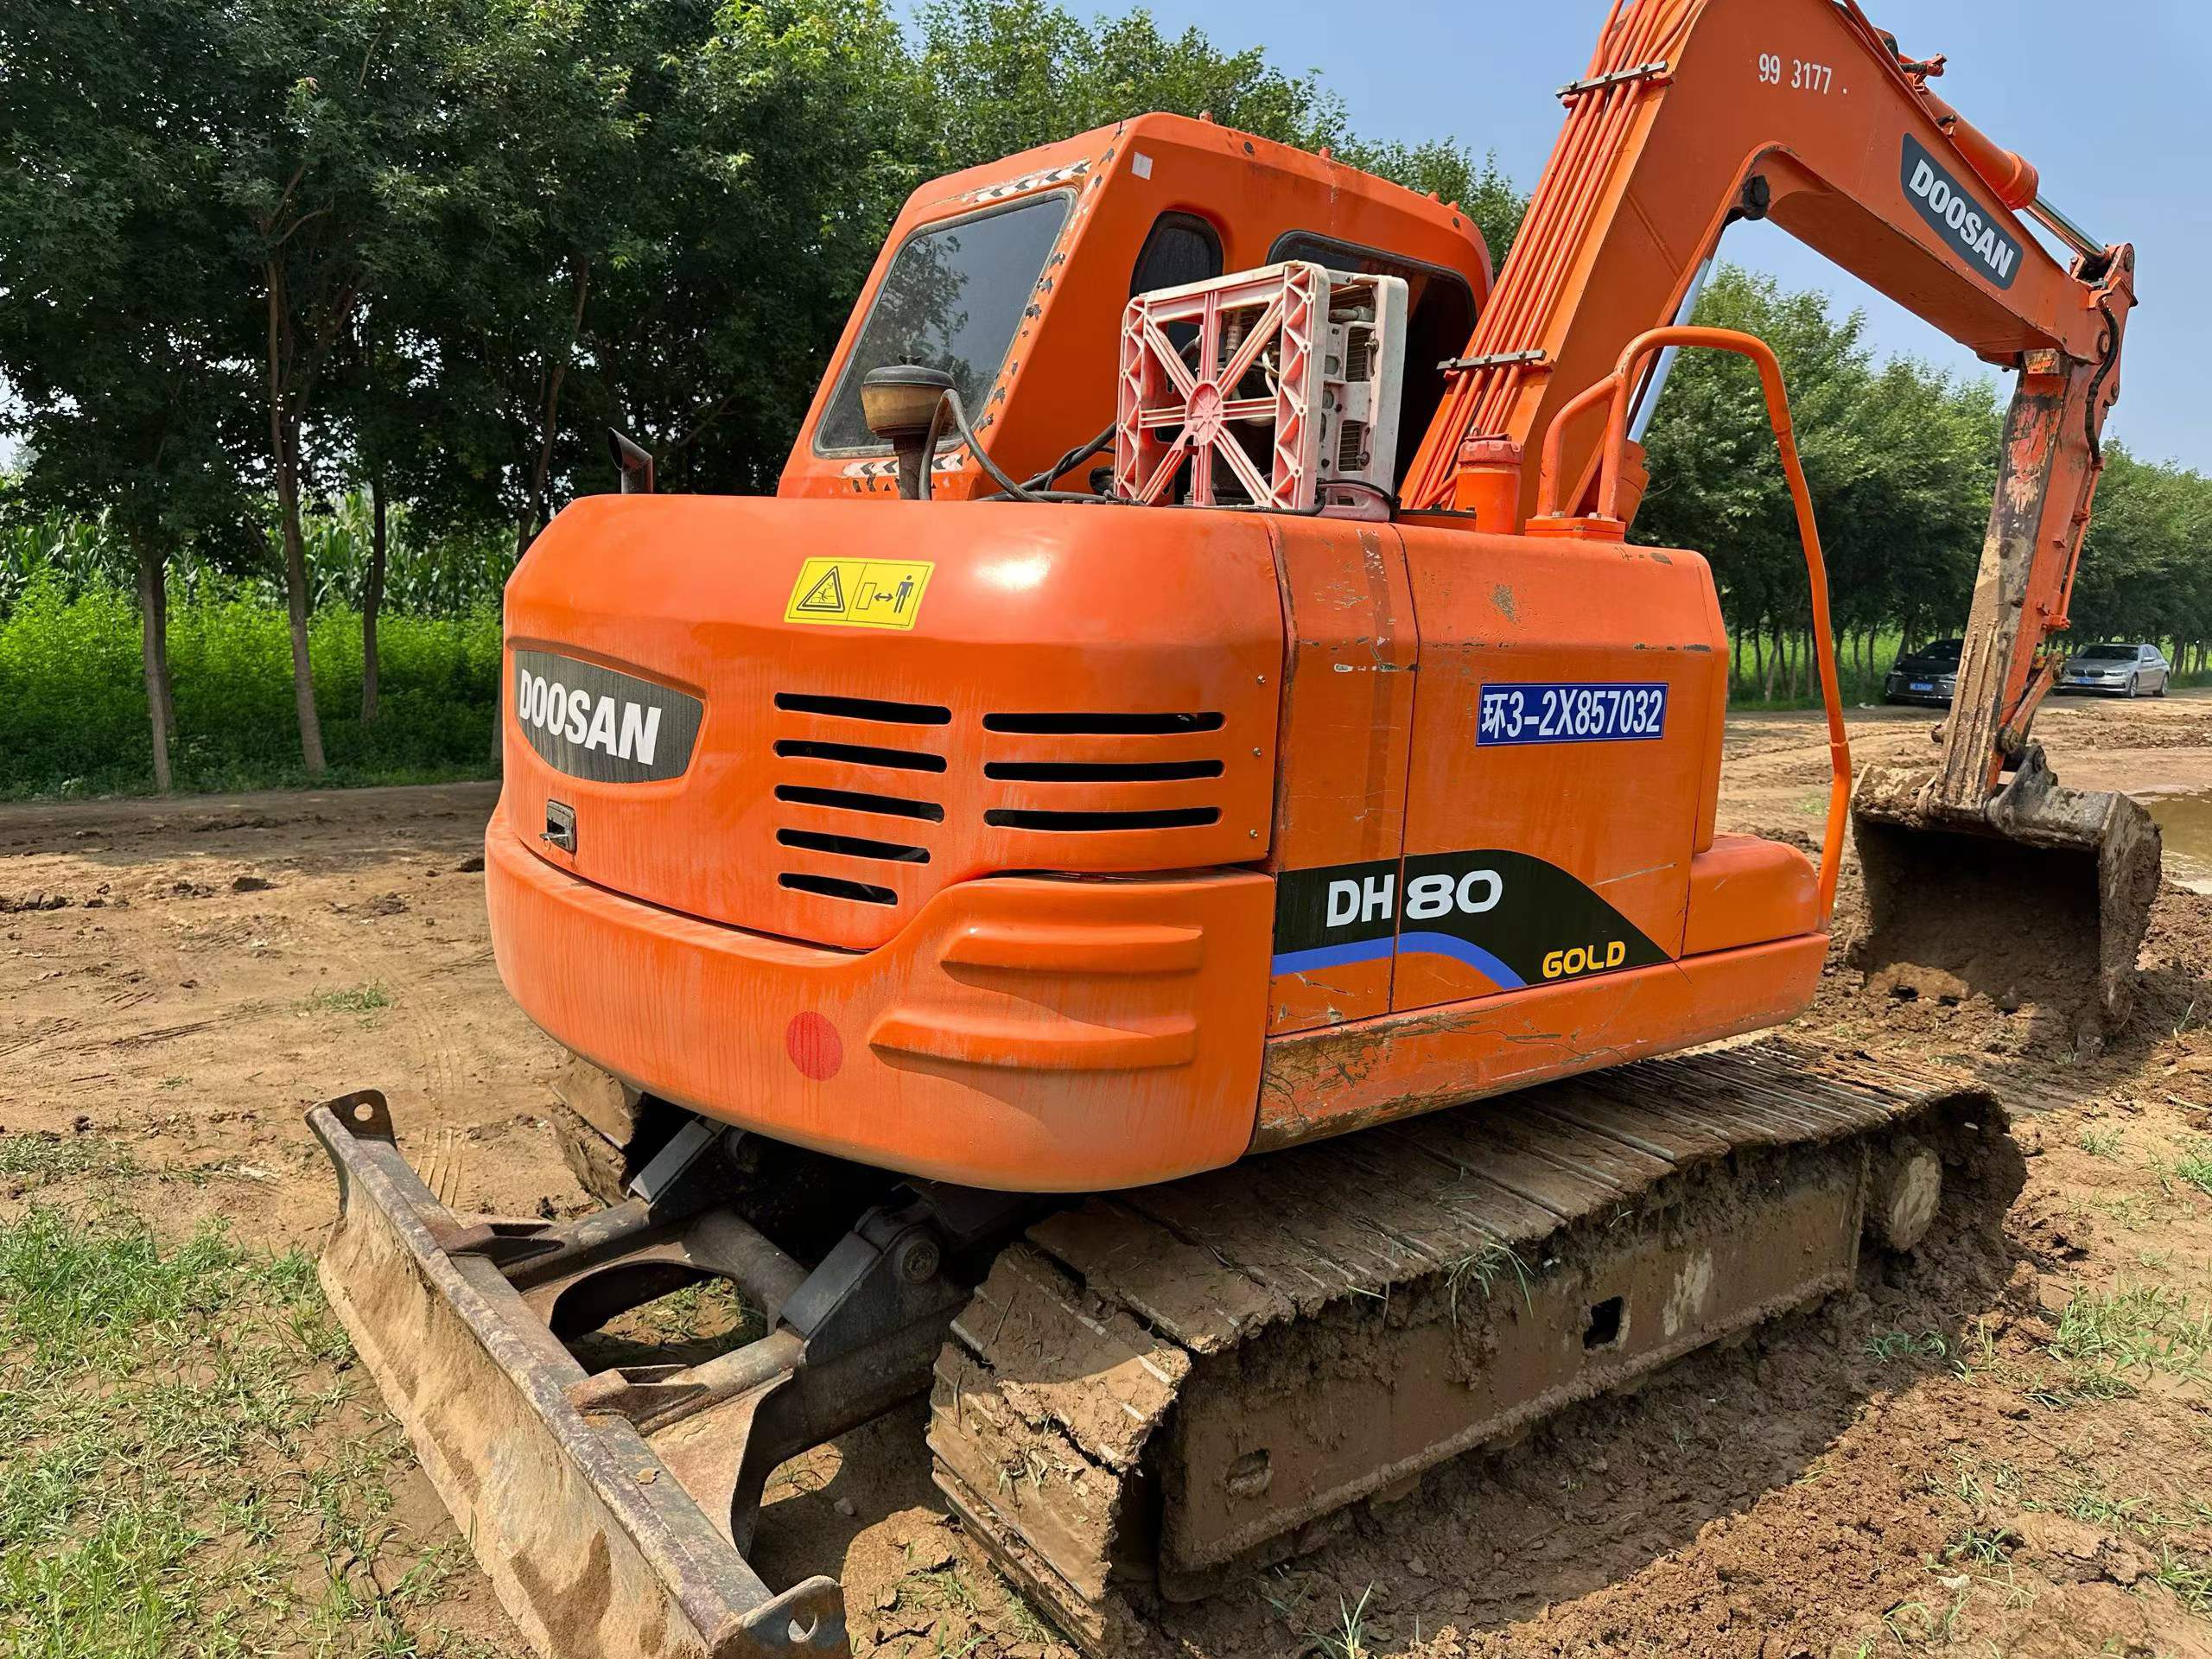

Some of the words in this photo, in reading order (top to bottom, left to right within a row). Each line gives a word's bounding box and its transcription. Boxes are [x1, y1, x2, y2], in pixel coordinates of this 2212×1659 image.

[1758, 53, 1781, 85] 99
[1790, 59, 1833, 94] 3177
[1908, 158, 2014, 278] DOOSAN
[519, 668, 663, 766] DOOSAN
[1481, 689, 1662, 739] 环3-2X857032
[1541, 940, 1626, 979] GOLD
